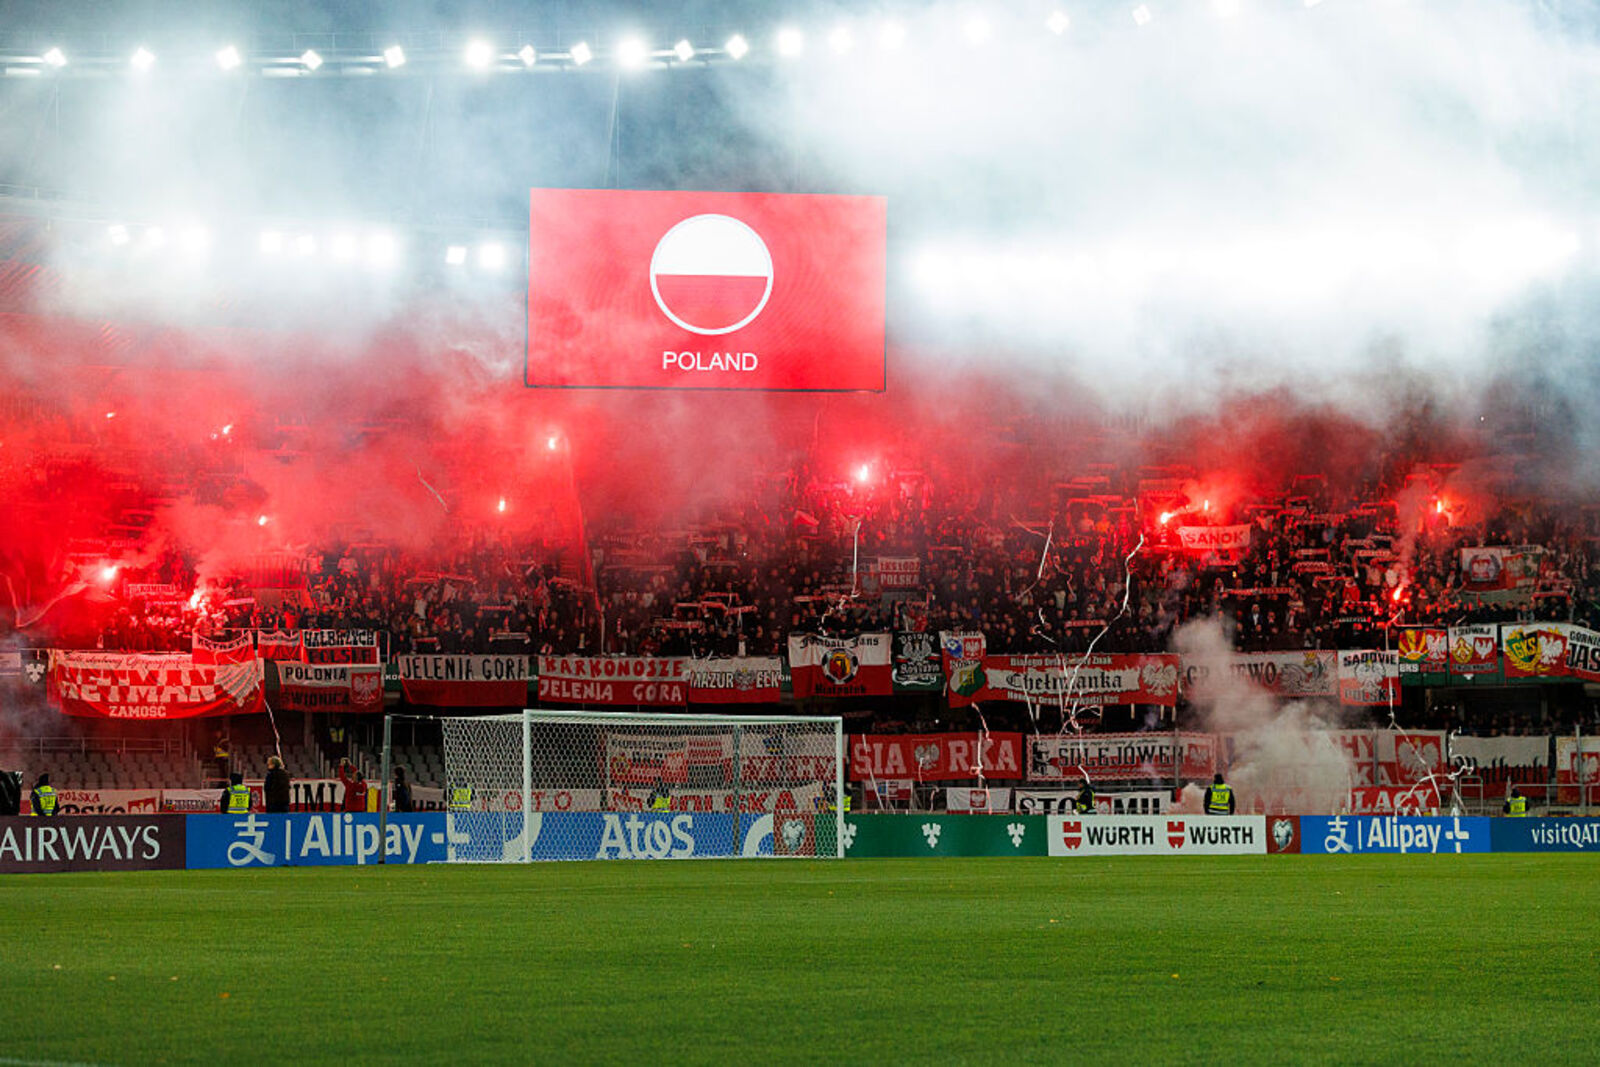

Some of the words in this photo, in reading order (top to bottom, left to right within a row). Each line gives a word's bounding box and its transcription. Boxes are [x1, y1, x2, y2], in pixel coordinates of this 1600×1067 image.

[662, 351, 758, 371] POLAND
[1184, 529, 1245, 545] SANOK
[1512, 638, 1536, 660] GKS
[285, 666, 347, 681] POLONIA
[402, 657, 473, 679] JELENIA
[544, 657, 684, 678] KARKONOSZE
[540, 679, 613, 701] JELENIA
[690, 671, 734, 688] MAZUR
[854, 743, 907, 775] SIA
[58, 792, 100, 803] POLSKA
[0, 826, 161, 862] AIRWAYS
[301, 814, 425, 865] Alipay
[1366, 816, 1442, 854] Alipay
